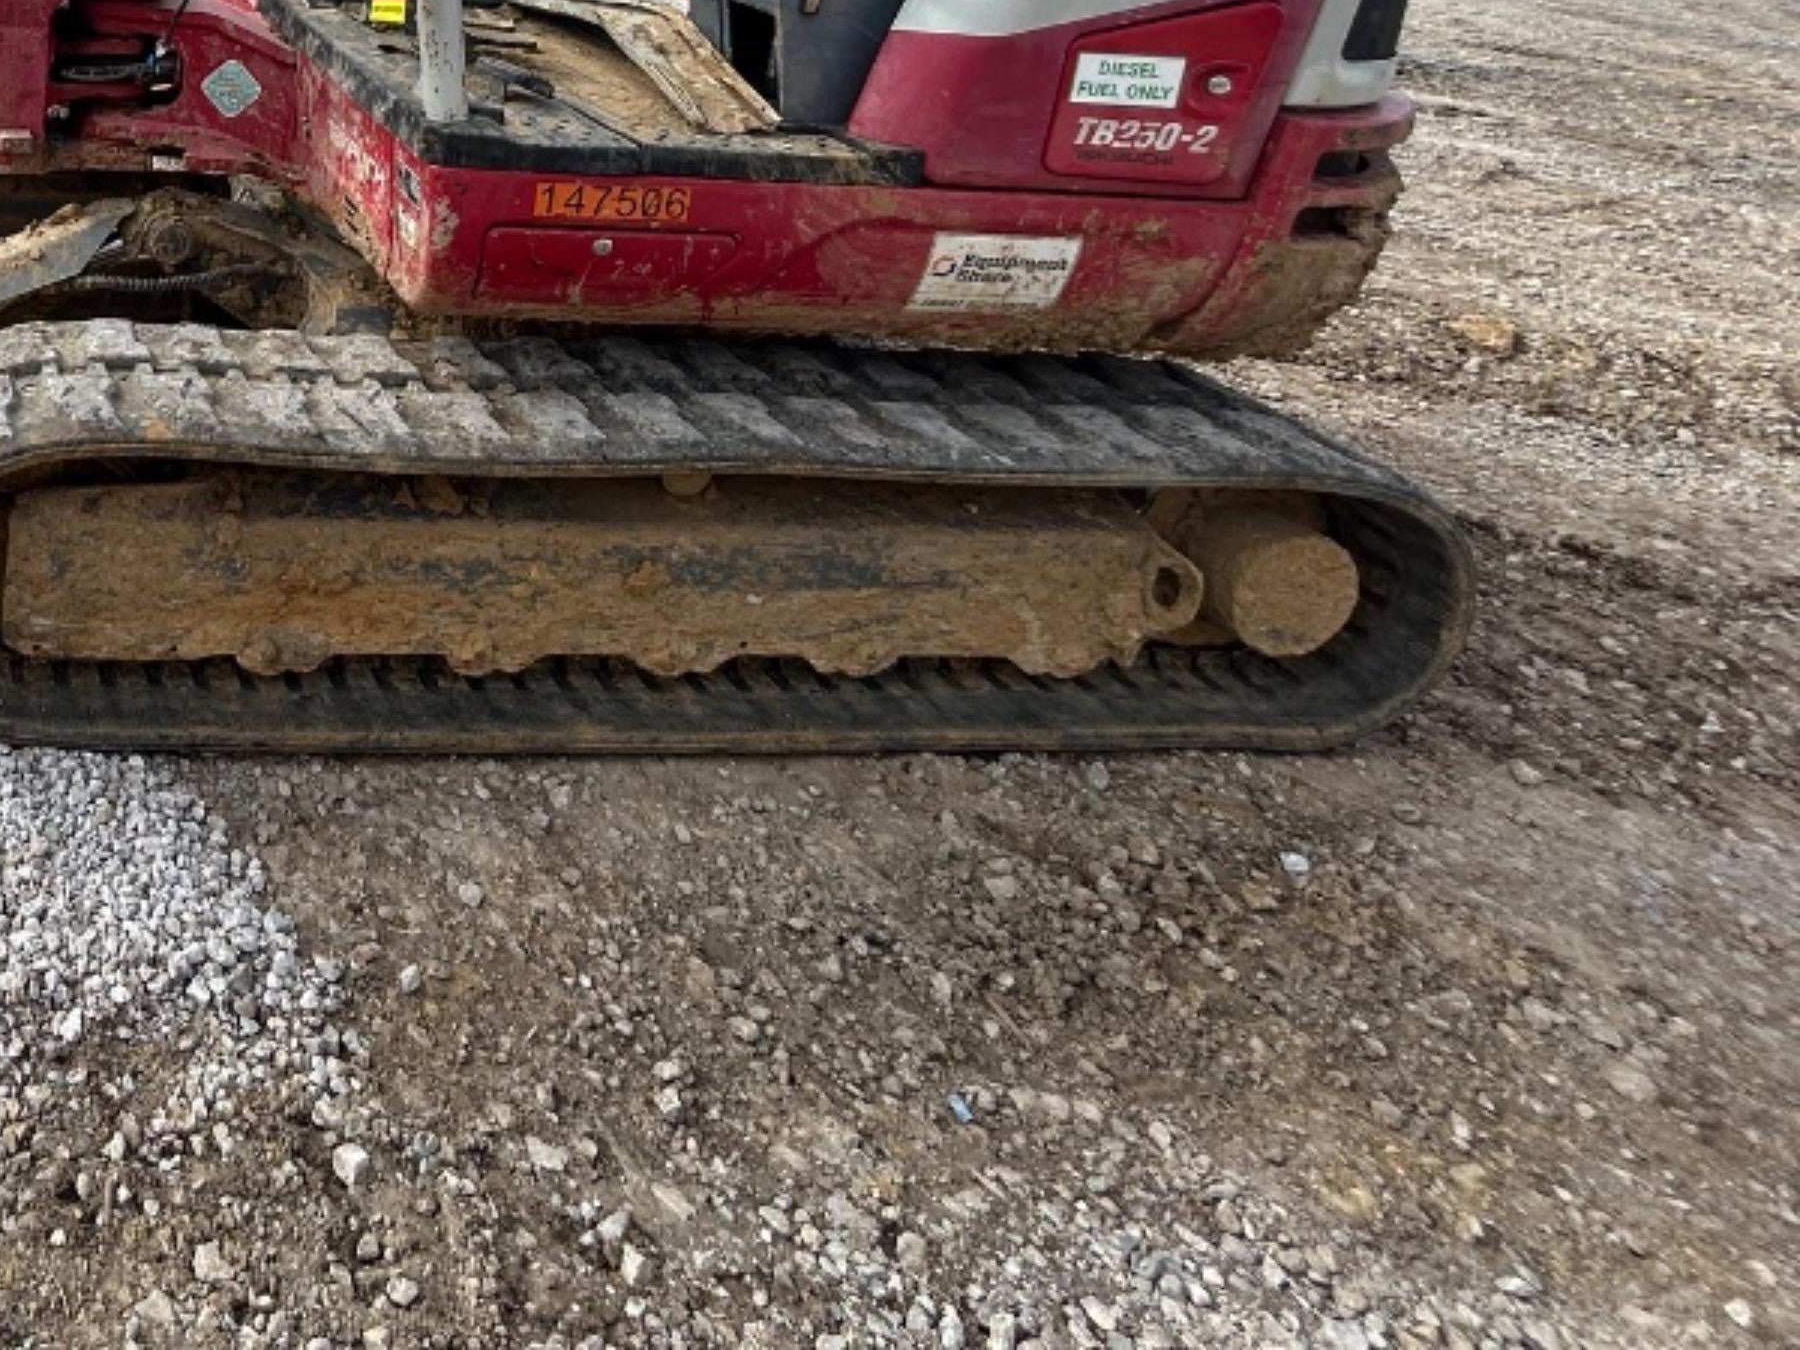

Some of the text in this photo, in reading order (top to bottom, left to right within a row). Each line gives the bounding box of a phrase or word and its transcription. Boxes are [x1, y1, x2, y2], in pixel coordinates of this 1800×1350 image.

[1098, 60, 1160, 79] DIESEL
[1076, 81, 1175, 101] FUEL ONLY
[1073, 116, 1220, 154] TB250-2
[541, 184, 688, 219] 147506
